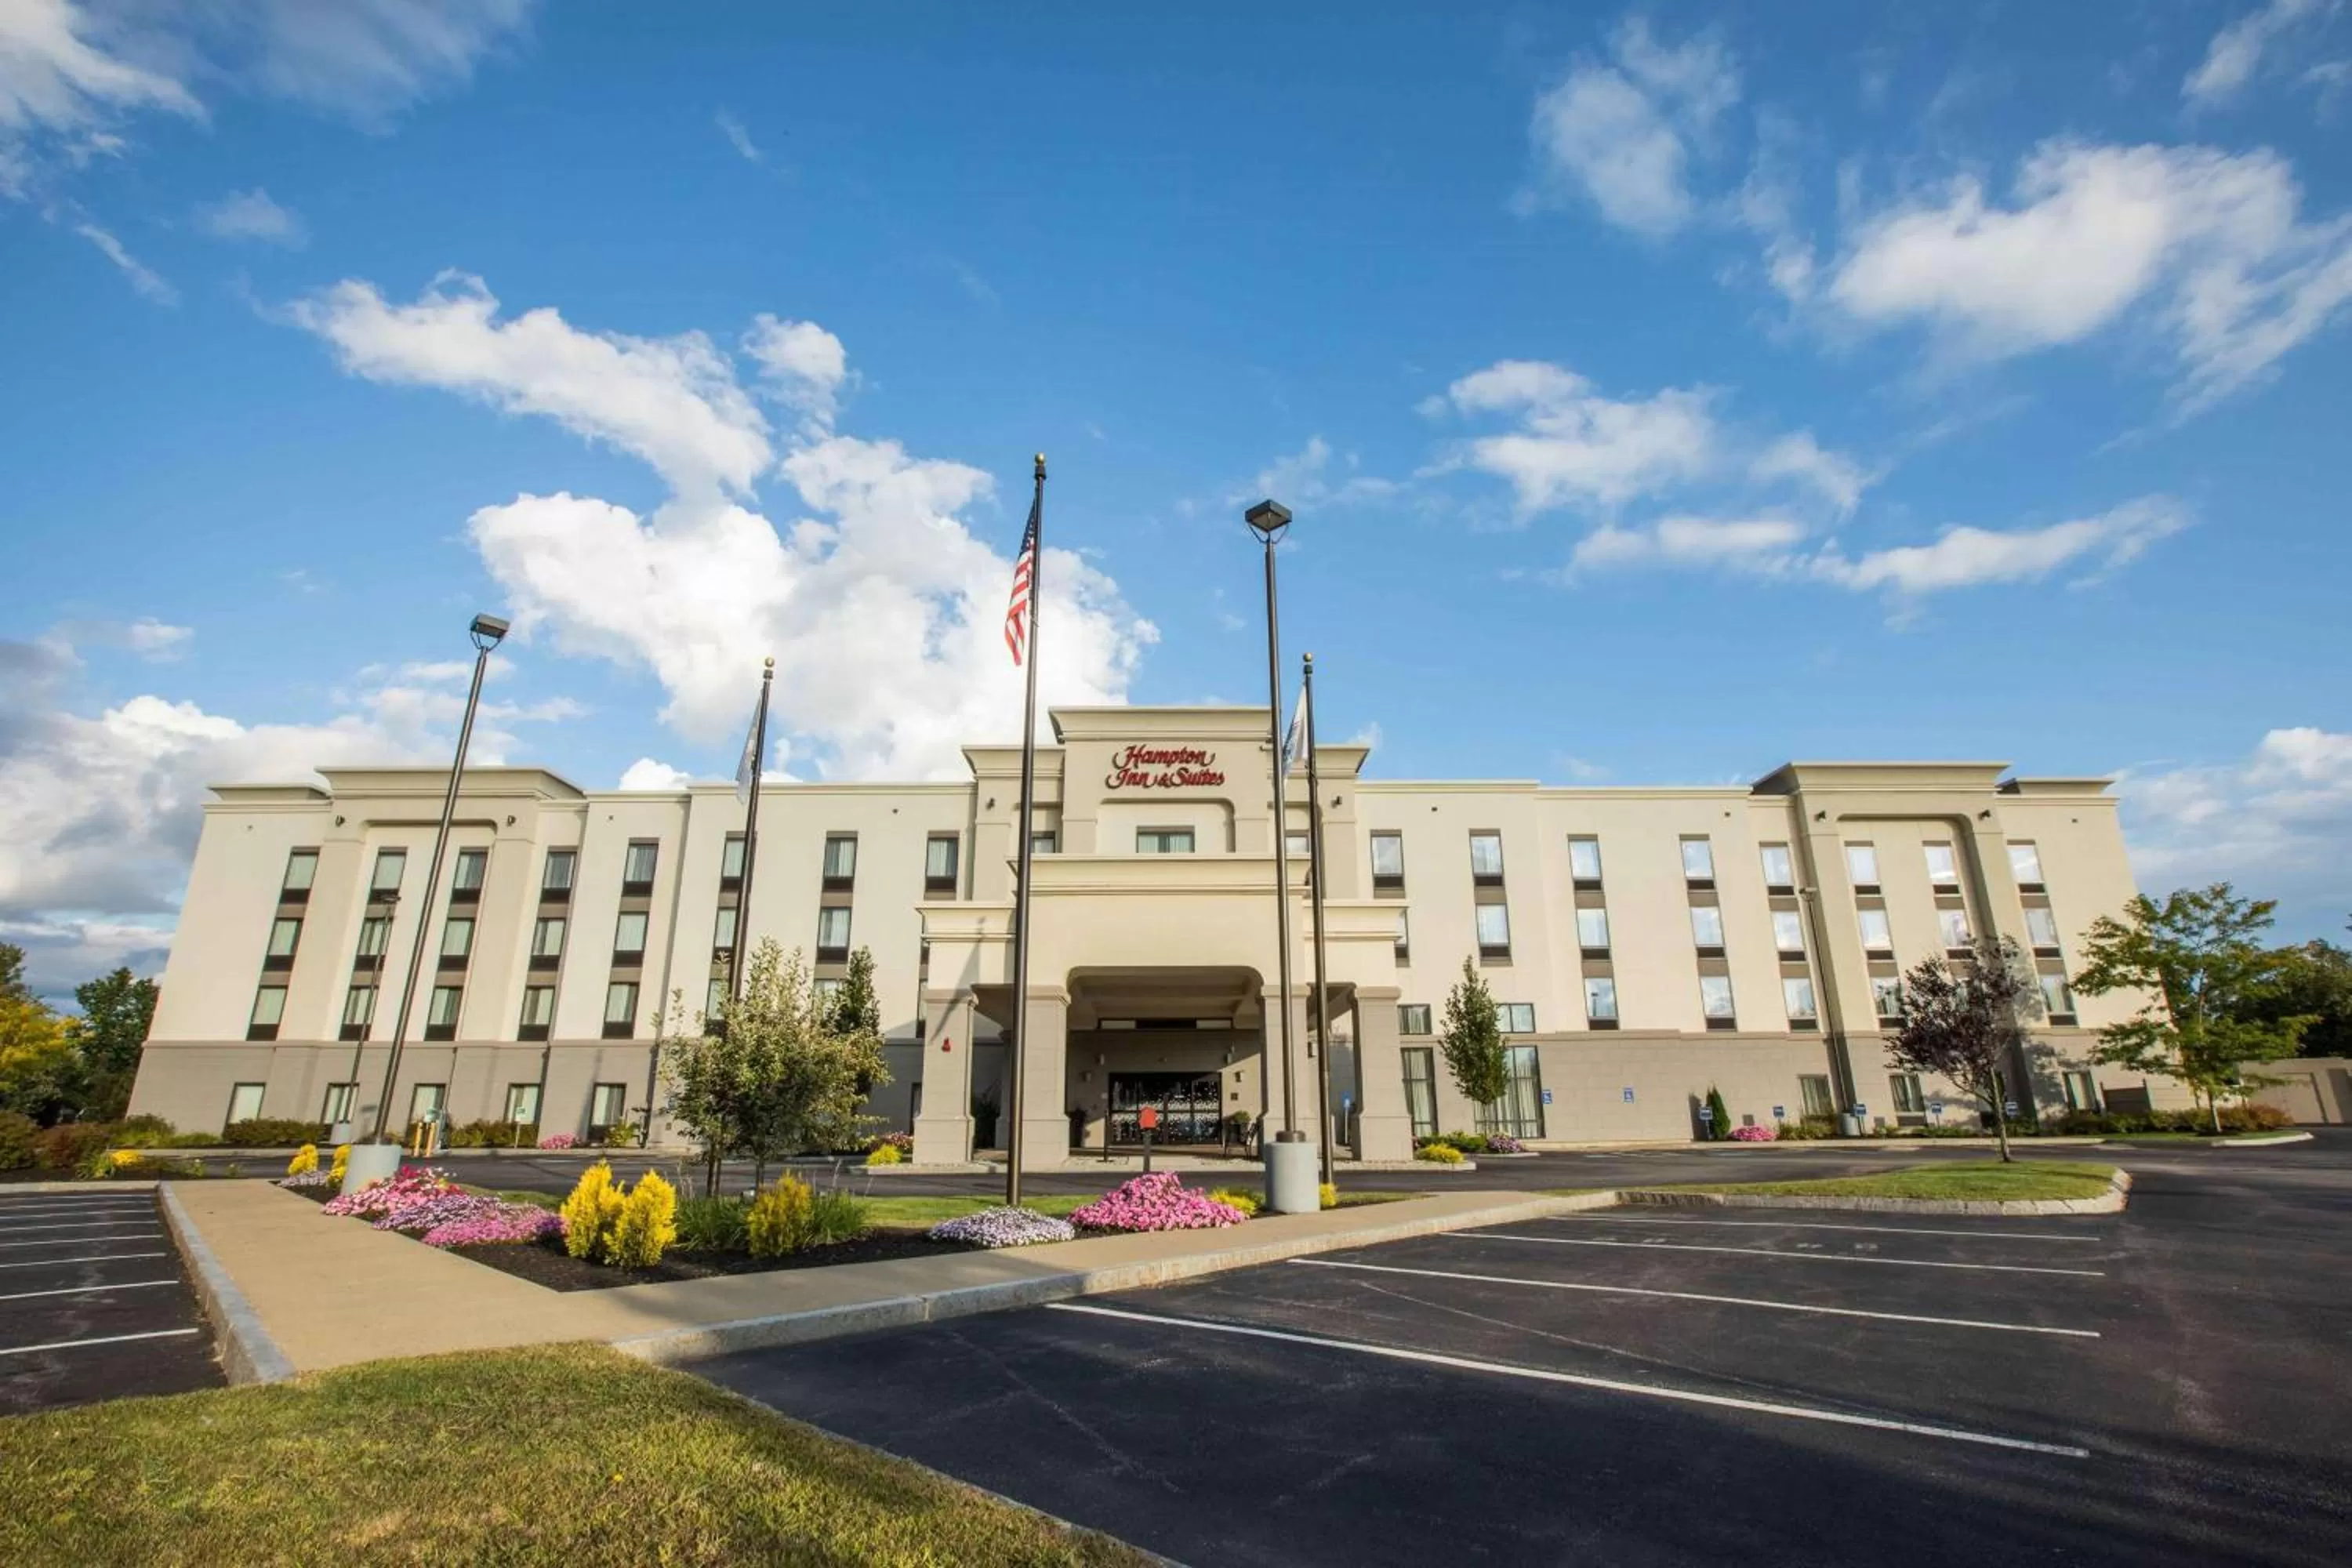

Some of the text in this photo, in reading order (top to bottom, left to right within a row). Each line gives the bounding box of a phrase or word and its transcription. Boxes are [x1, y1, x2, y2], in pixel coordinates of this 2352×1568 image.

[1112, 744, 1216, 769] Hampton
[1105, 767, 1225, 789] Inn & Suites
